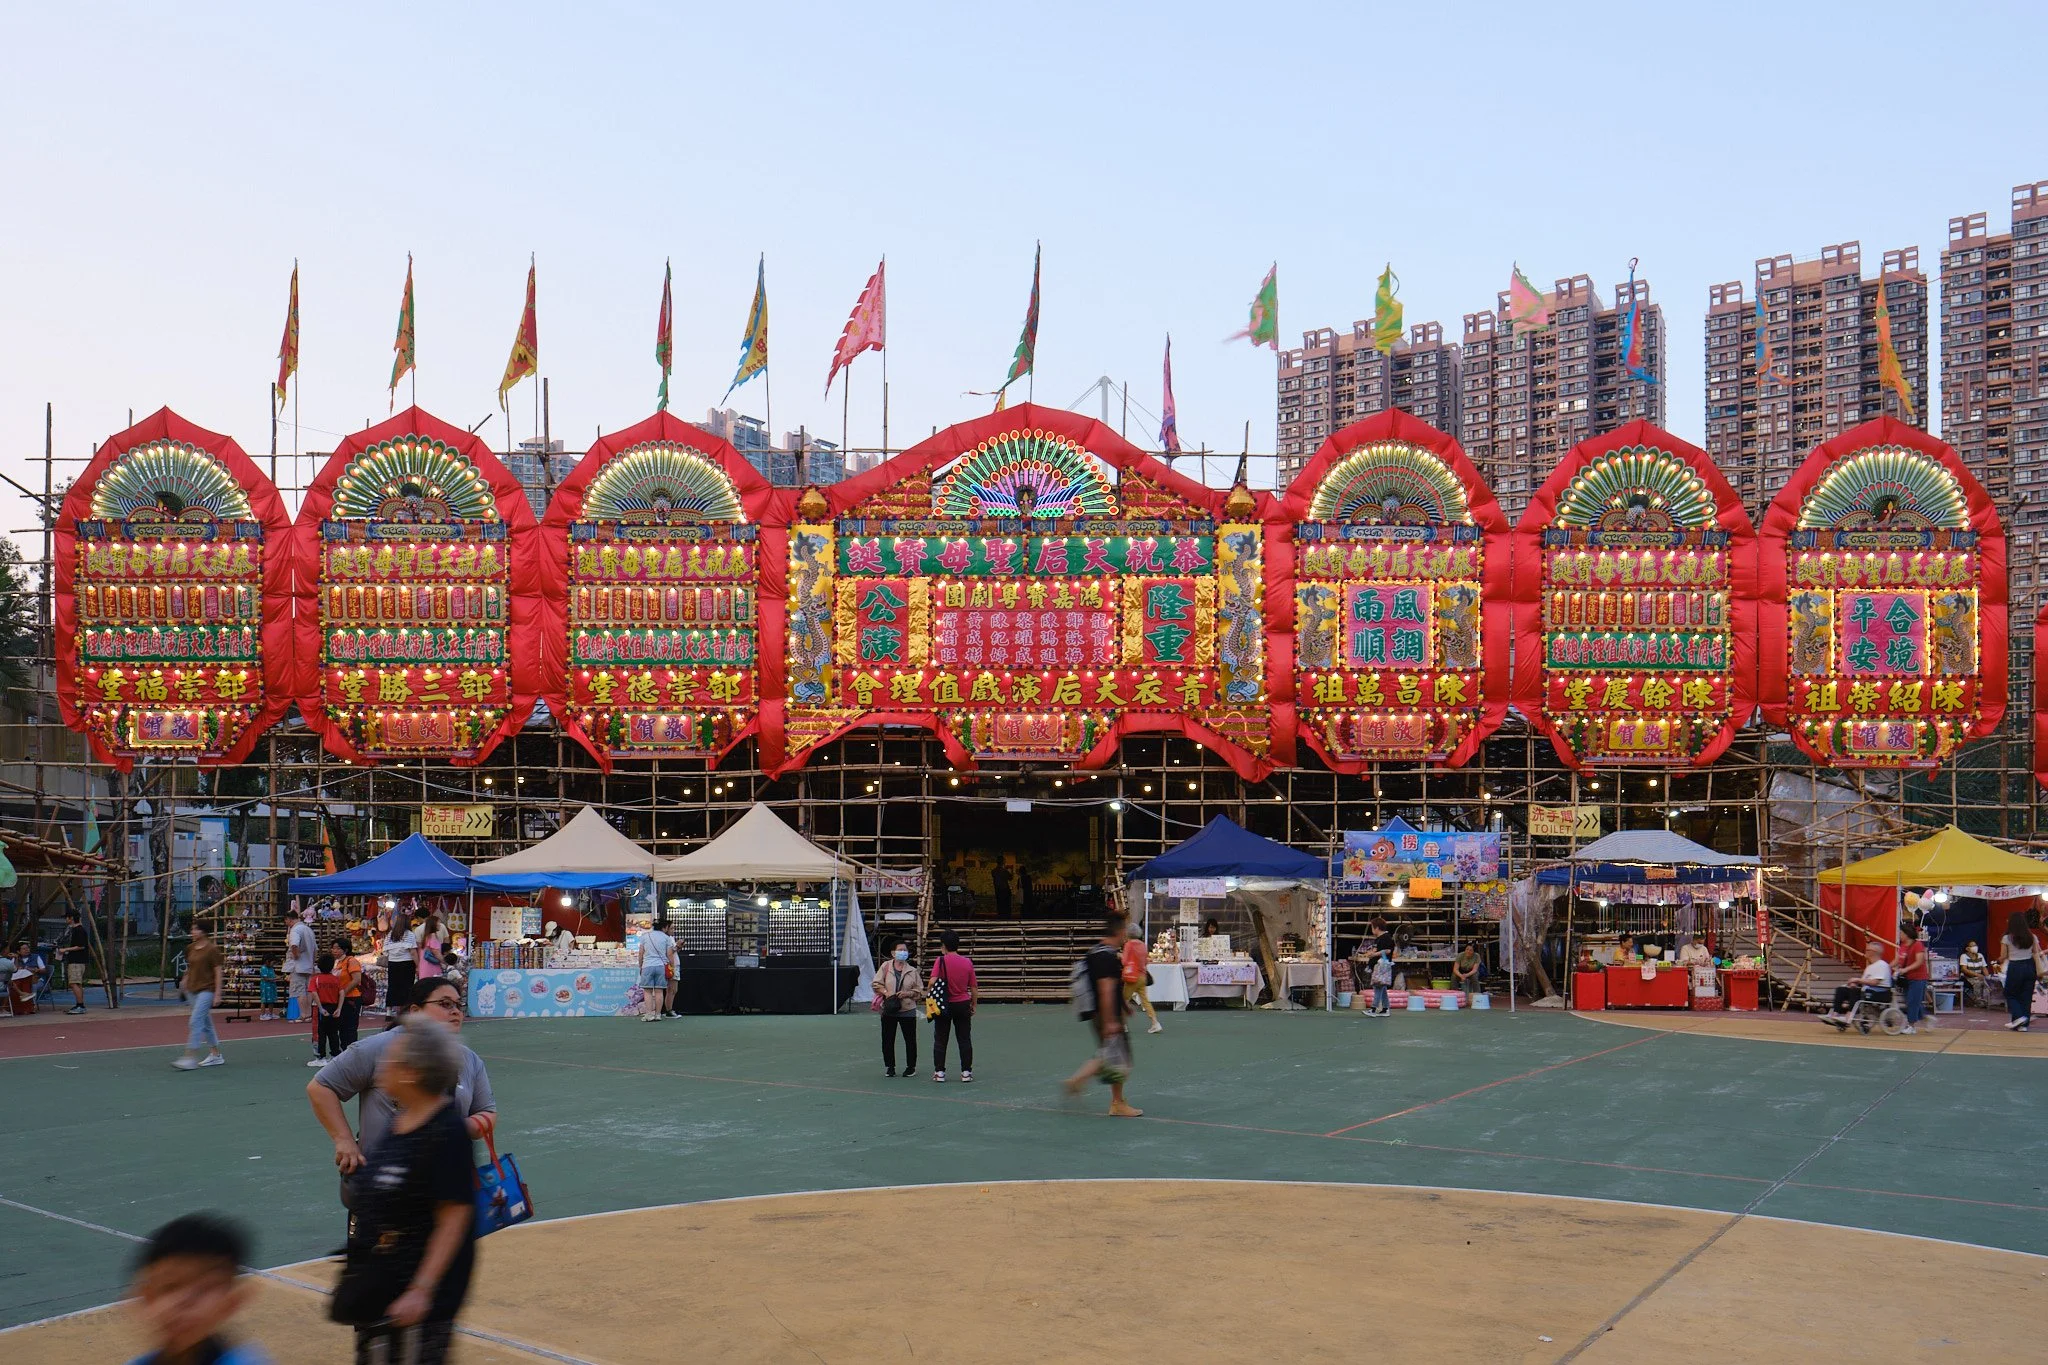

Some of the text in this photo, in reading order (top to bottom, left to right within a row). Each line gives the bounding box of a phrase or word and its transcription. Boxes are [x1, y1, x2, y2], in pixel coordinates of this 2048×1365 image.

[87, 546, 256, 578] 恭祝天后聖母寶誕
[330, 546, 503, 578] 恭祝天后聖母寶誕
[577, 547, 750, 579] 恭祝天后聖母寶誕
[846, 540, 1209, 575] 恭祝天后聖母寶誕
[1303, 548, 1476, 578] 恭祝天后聖母寶誕
[1551, 553, 1723, 585] 恭祝天后聖母寶誕
[1796, 554, 1971, 586] 恭祝天后聖母寶誕
[945, 583, 1103, 610] 鴻嘉寶粵劇團
[857, 584, 907, 663] 公演
[965, 613, 983, 664] 黃成彬
[1015, 613, 1033, 664] 黎耀威
[1040, 613, 1059, 664] 陳鴻進
[1065, 613, 1084, 664] 鄭詠梅
[1090, 613, 1109, 664] 龍貫天
[1146, 584, 1194, 663] 隆重
[1353, 588, 1386, 664] 雨順
[1391, 588, 1425, 663] 風調
[1847, 596, 1881, 672] 平安
[1884, 596, 1920, 673] 合境
[97, 670, 247, 702] 鄧崇福堂
[338, 670, 494, 704] 鄧三勝堂
[587, 671, 741, 704] 鄧崇德堂
[847, 672, 1209, 707] 青衣天后演戲值理會
[1312, 673, 1468, 707] 陳昌萬祖
[1563, 677, 1717, 711] 陳餘慶堂
[1804, 681, 1966, 714] 陳紹榮祖
[144, 715, 194, 739] 敬賀
[393, 717, 442, 740] 敬賀
[636, 717, 688, 741] 敬賀
[1003, 717, 1051, 743] 敬賀
[1368, 719, 1416, 743] 敬賀
[1616, 724, 1665, 747] 敬賀
[1858, 724, 1911, 749] 敬賀
[423, 807, 466, 823] 洗手間
[426, 824, 463, 834] TOILET
[1531, 806, 1574, 824] 洗手間
[1534, 824, 1572, 834] TOILET
[1402, 833, 1442, 879] 撈金魚
